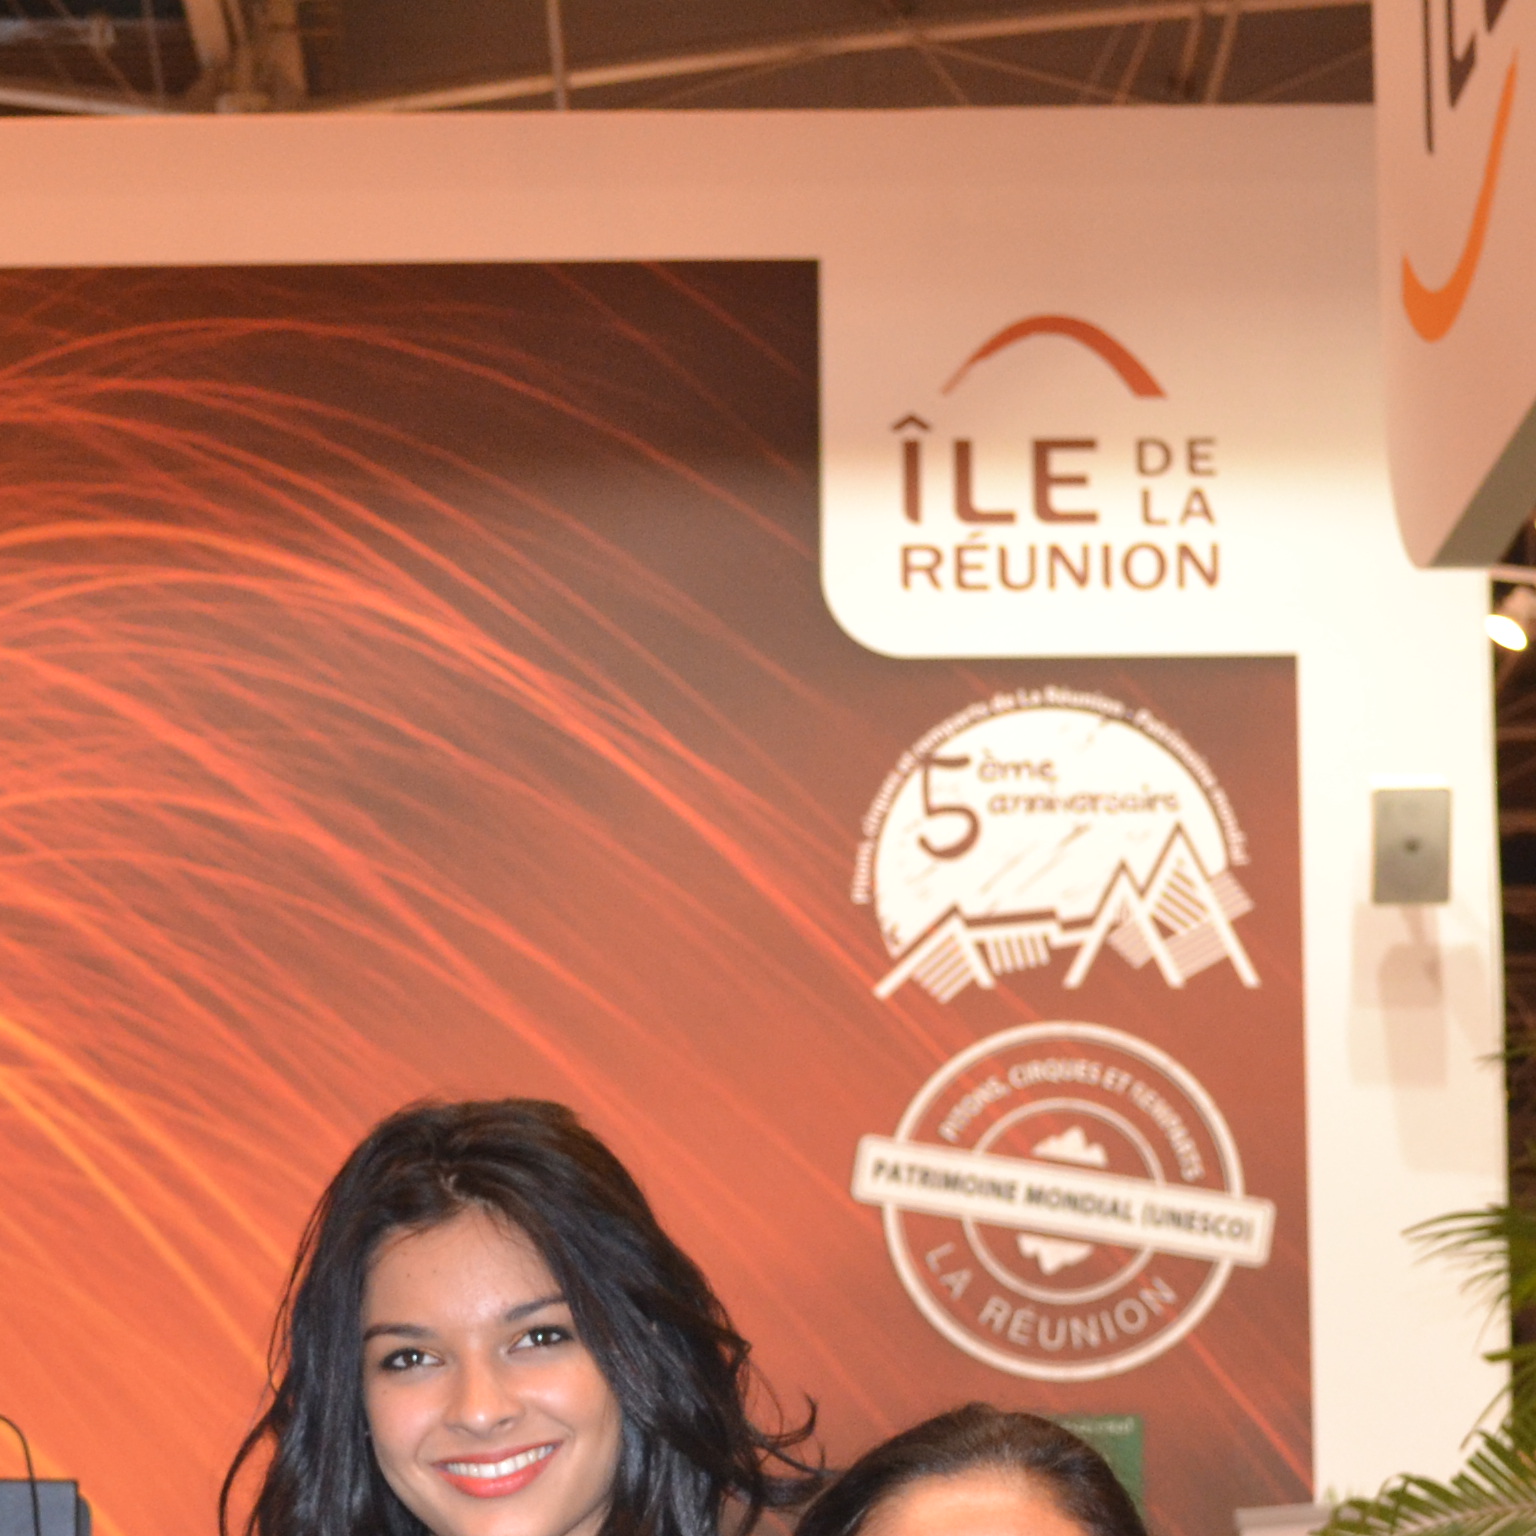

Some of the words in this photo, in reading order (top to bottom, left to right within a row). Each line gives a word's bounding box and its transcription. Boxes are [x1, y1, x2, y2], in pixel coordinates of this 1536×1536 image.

[891, 413, 1099, 525] ÎLE
[1135, 437, 1217, 477] DE
[1141, 486, 1217, 527] LA
[899, 531, 1220, 592] RÉUNION
[870, 1157, 1020, 1207] PATRIMOINE
[1023, 1183, 1135, 1226] MONDIAL
[925, 1241, 973, 1301] LA
[977, 1275, 1179, 1352] RÉUNION
